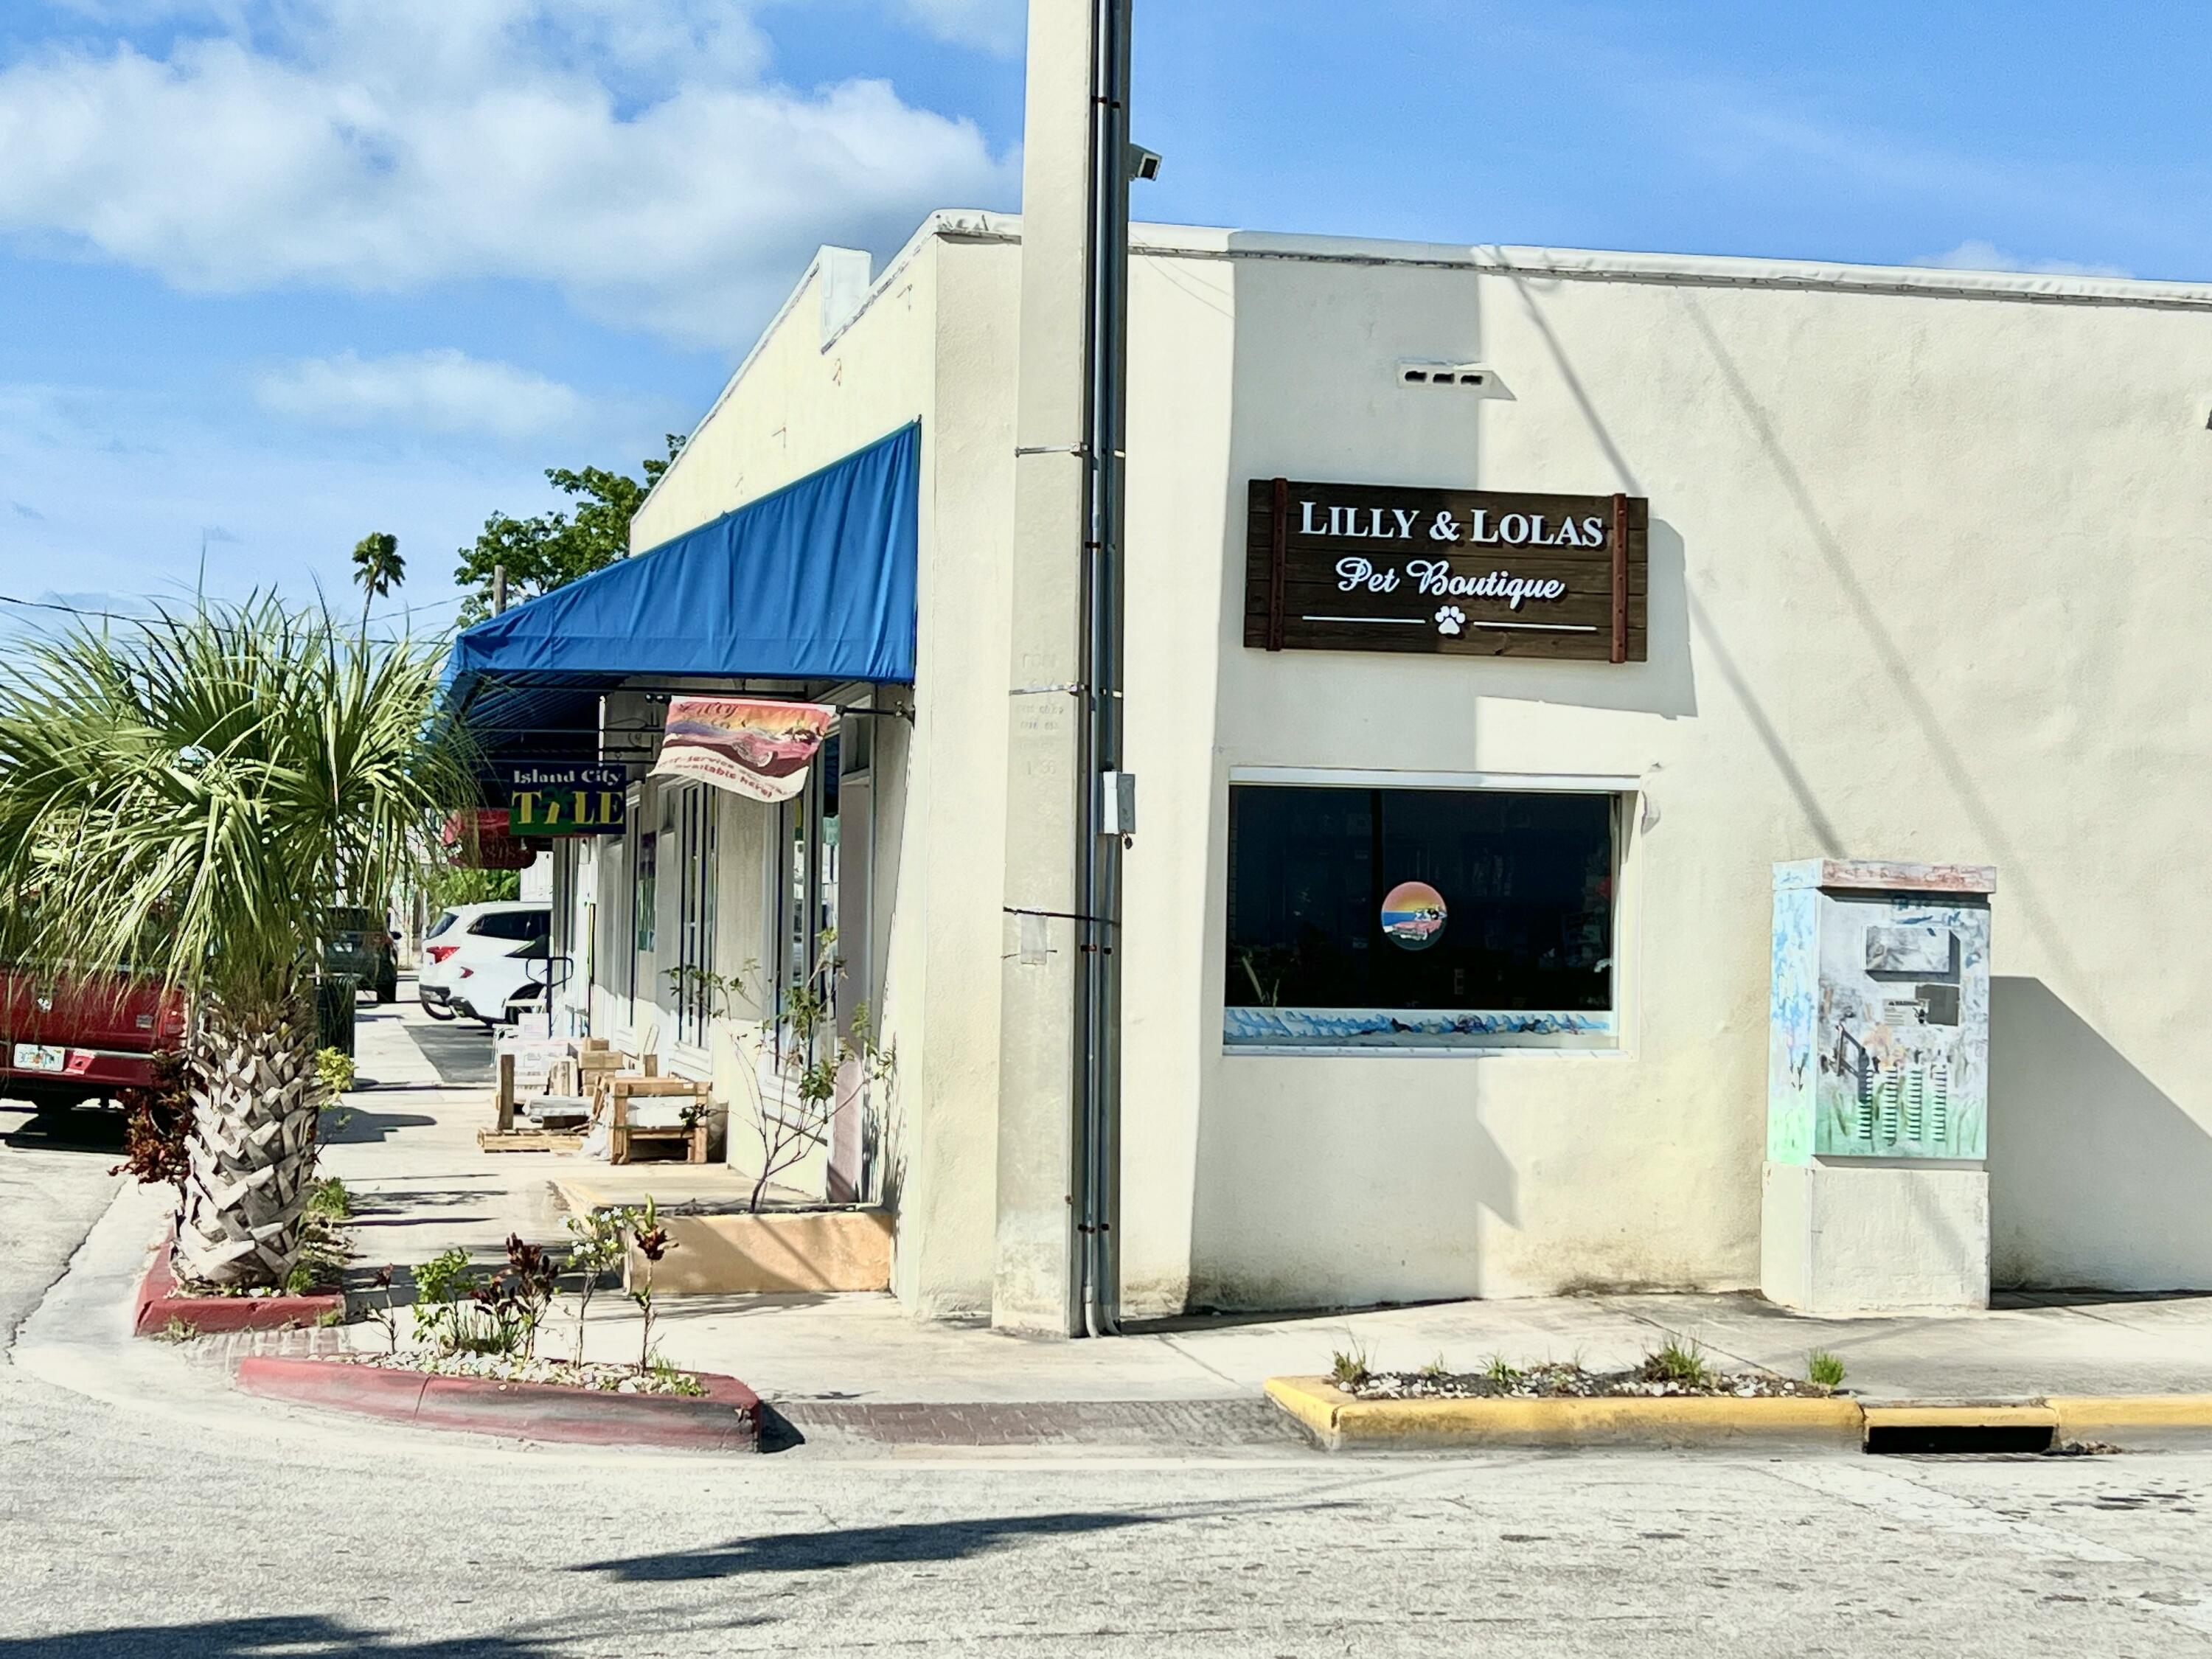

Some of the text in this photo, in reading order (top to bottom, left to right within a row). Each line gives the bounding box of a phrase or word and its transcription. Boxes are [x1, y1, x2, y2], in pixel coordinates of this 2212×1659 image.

[1299, 501, 1604, 546] LILLY & LOLAS
[1335, 557, 1566, 610] Pet Boutique
[514, 769, 622, 786] Island City
[512, 790, 624, 824] TILE
